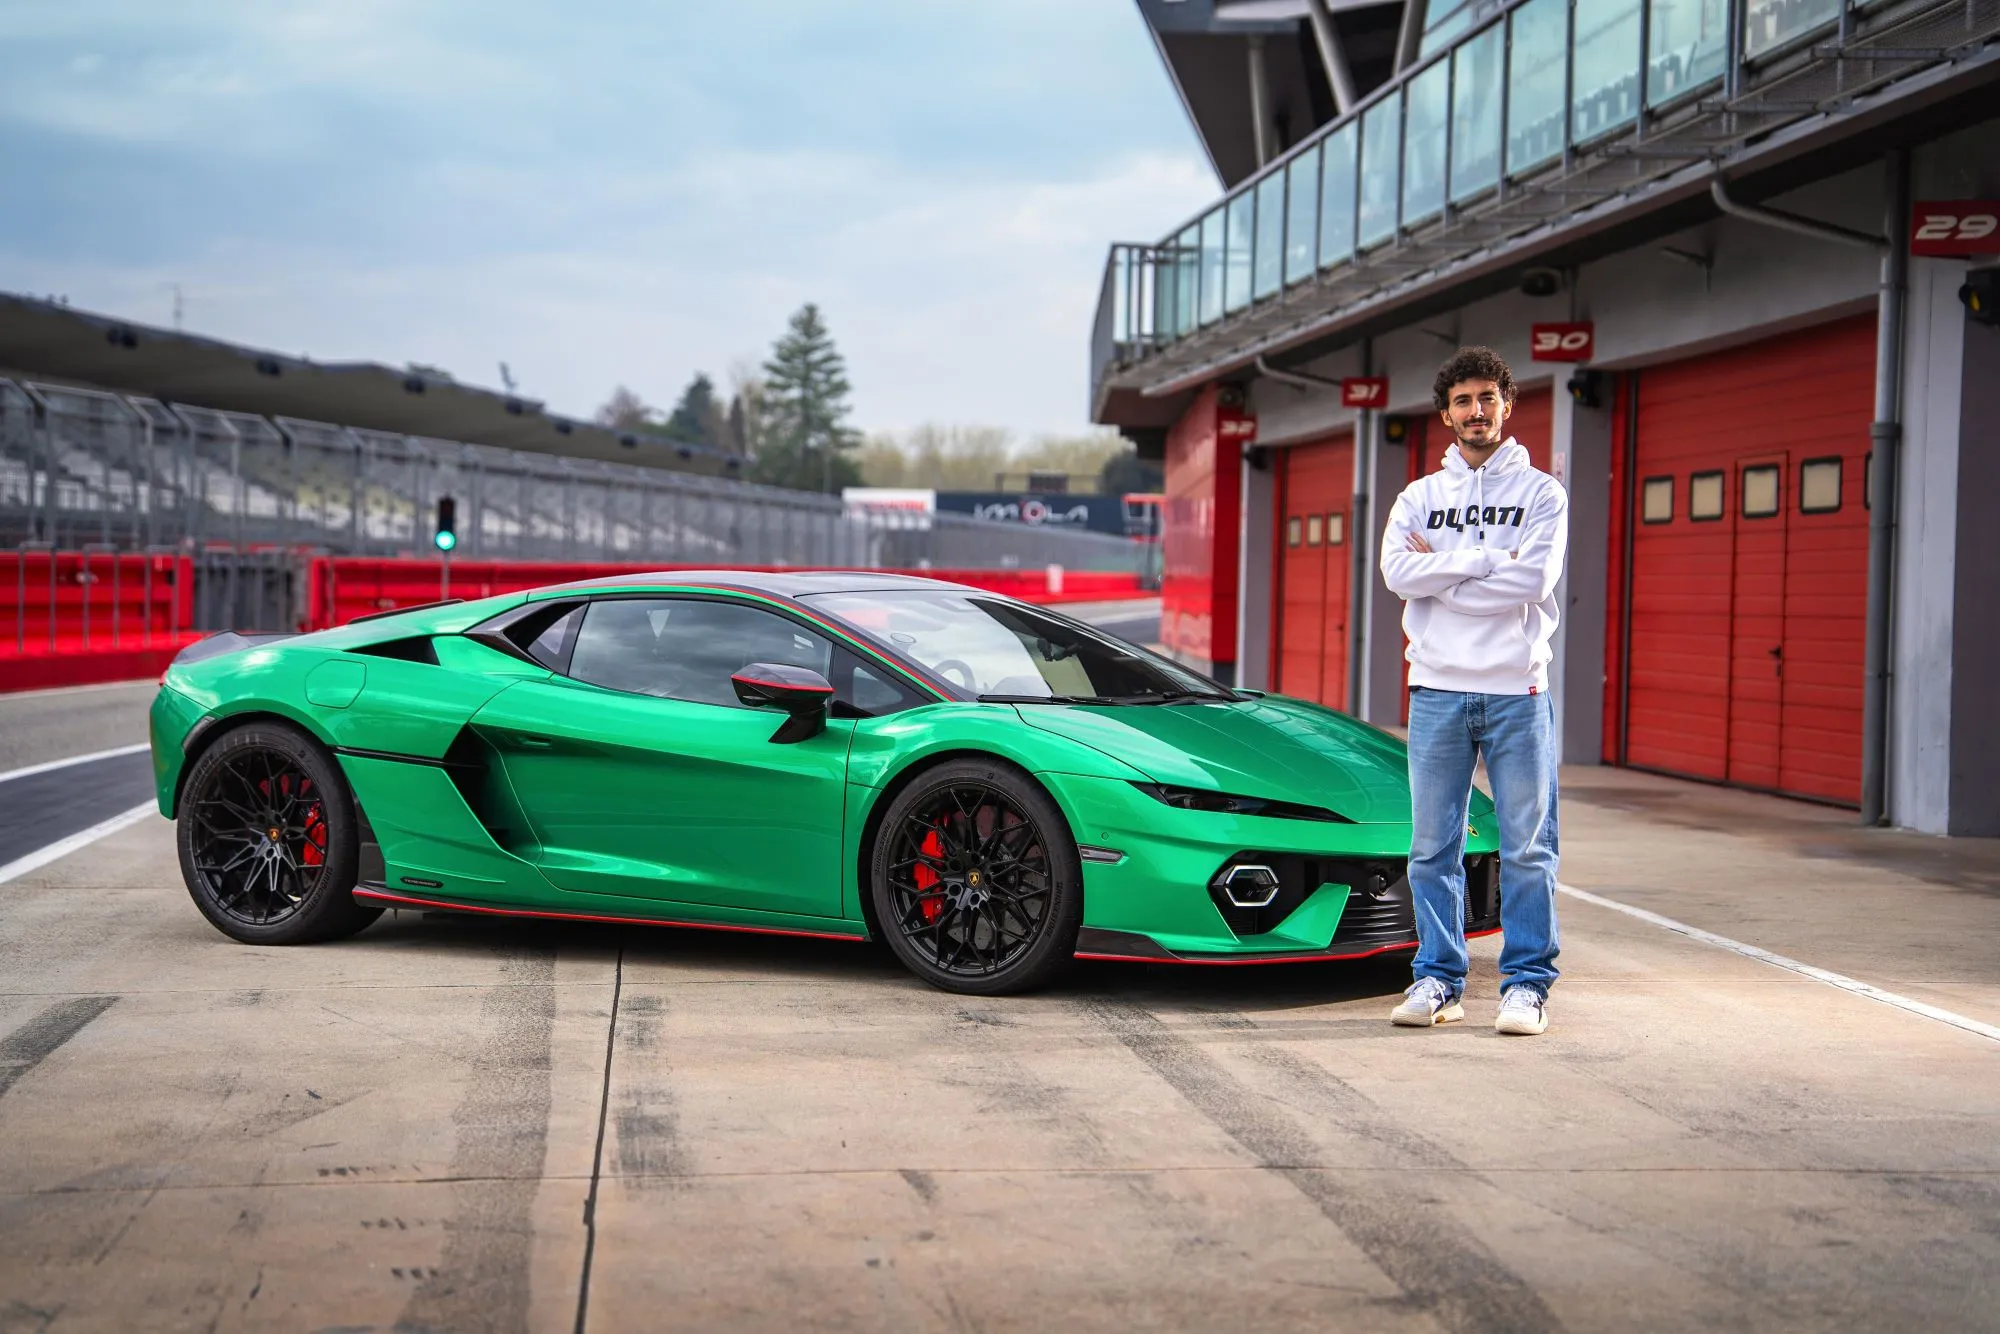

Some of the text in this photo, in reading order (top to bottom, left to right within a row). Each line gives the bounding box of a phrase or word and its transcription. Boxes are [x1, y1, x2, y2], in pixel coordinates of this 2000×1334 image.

[1915, 215, 1998, 240] 29
[1535, 332, 1590, 351] 30
[1347, 384, 1382, 401] 31
[1220, 420, 1254, 435] 32
[1427, 505, 1525, 529] DUCATI
